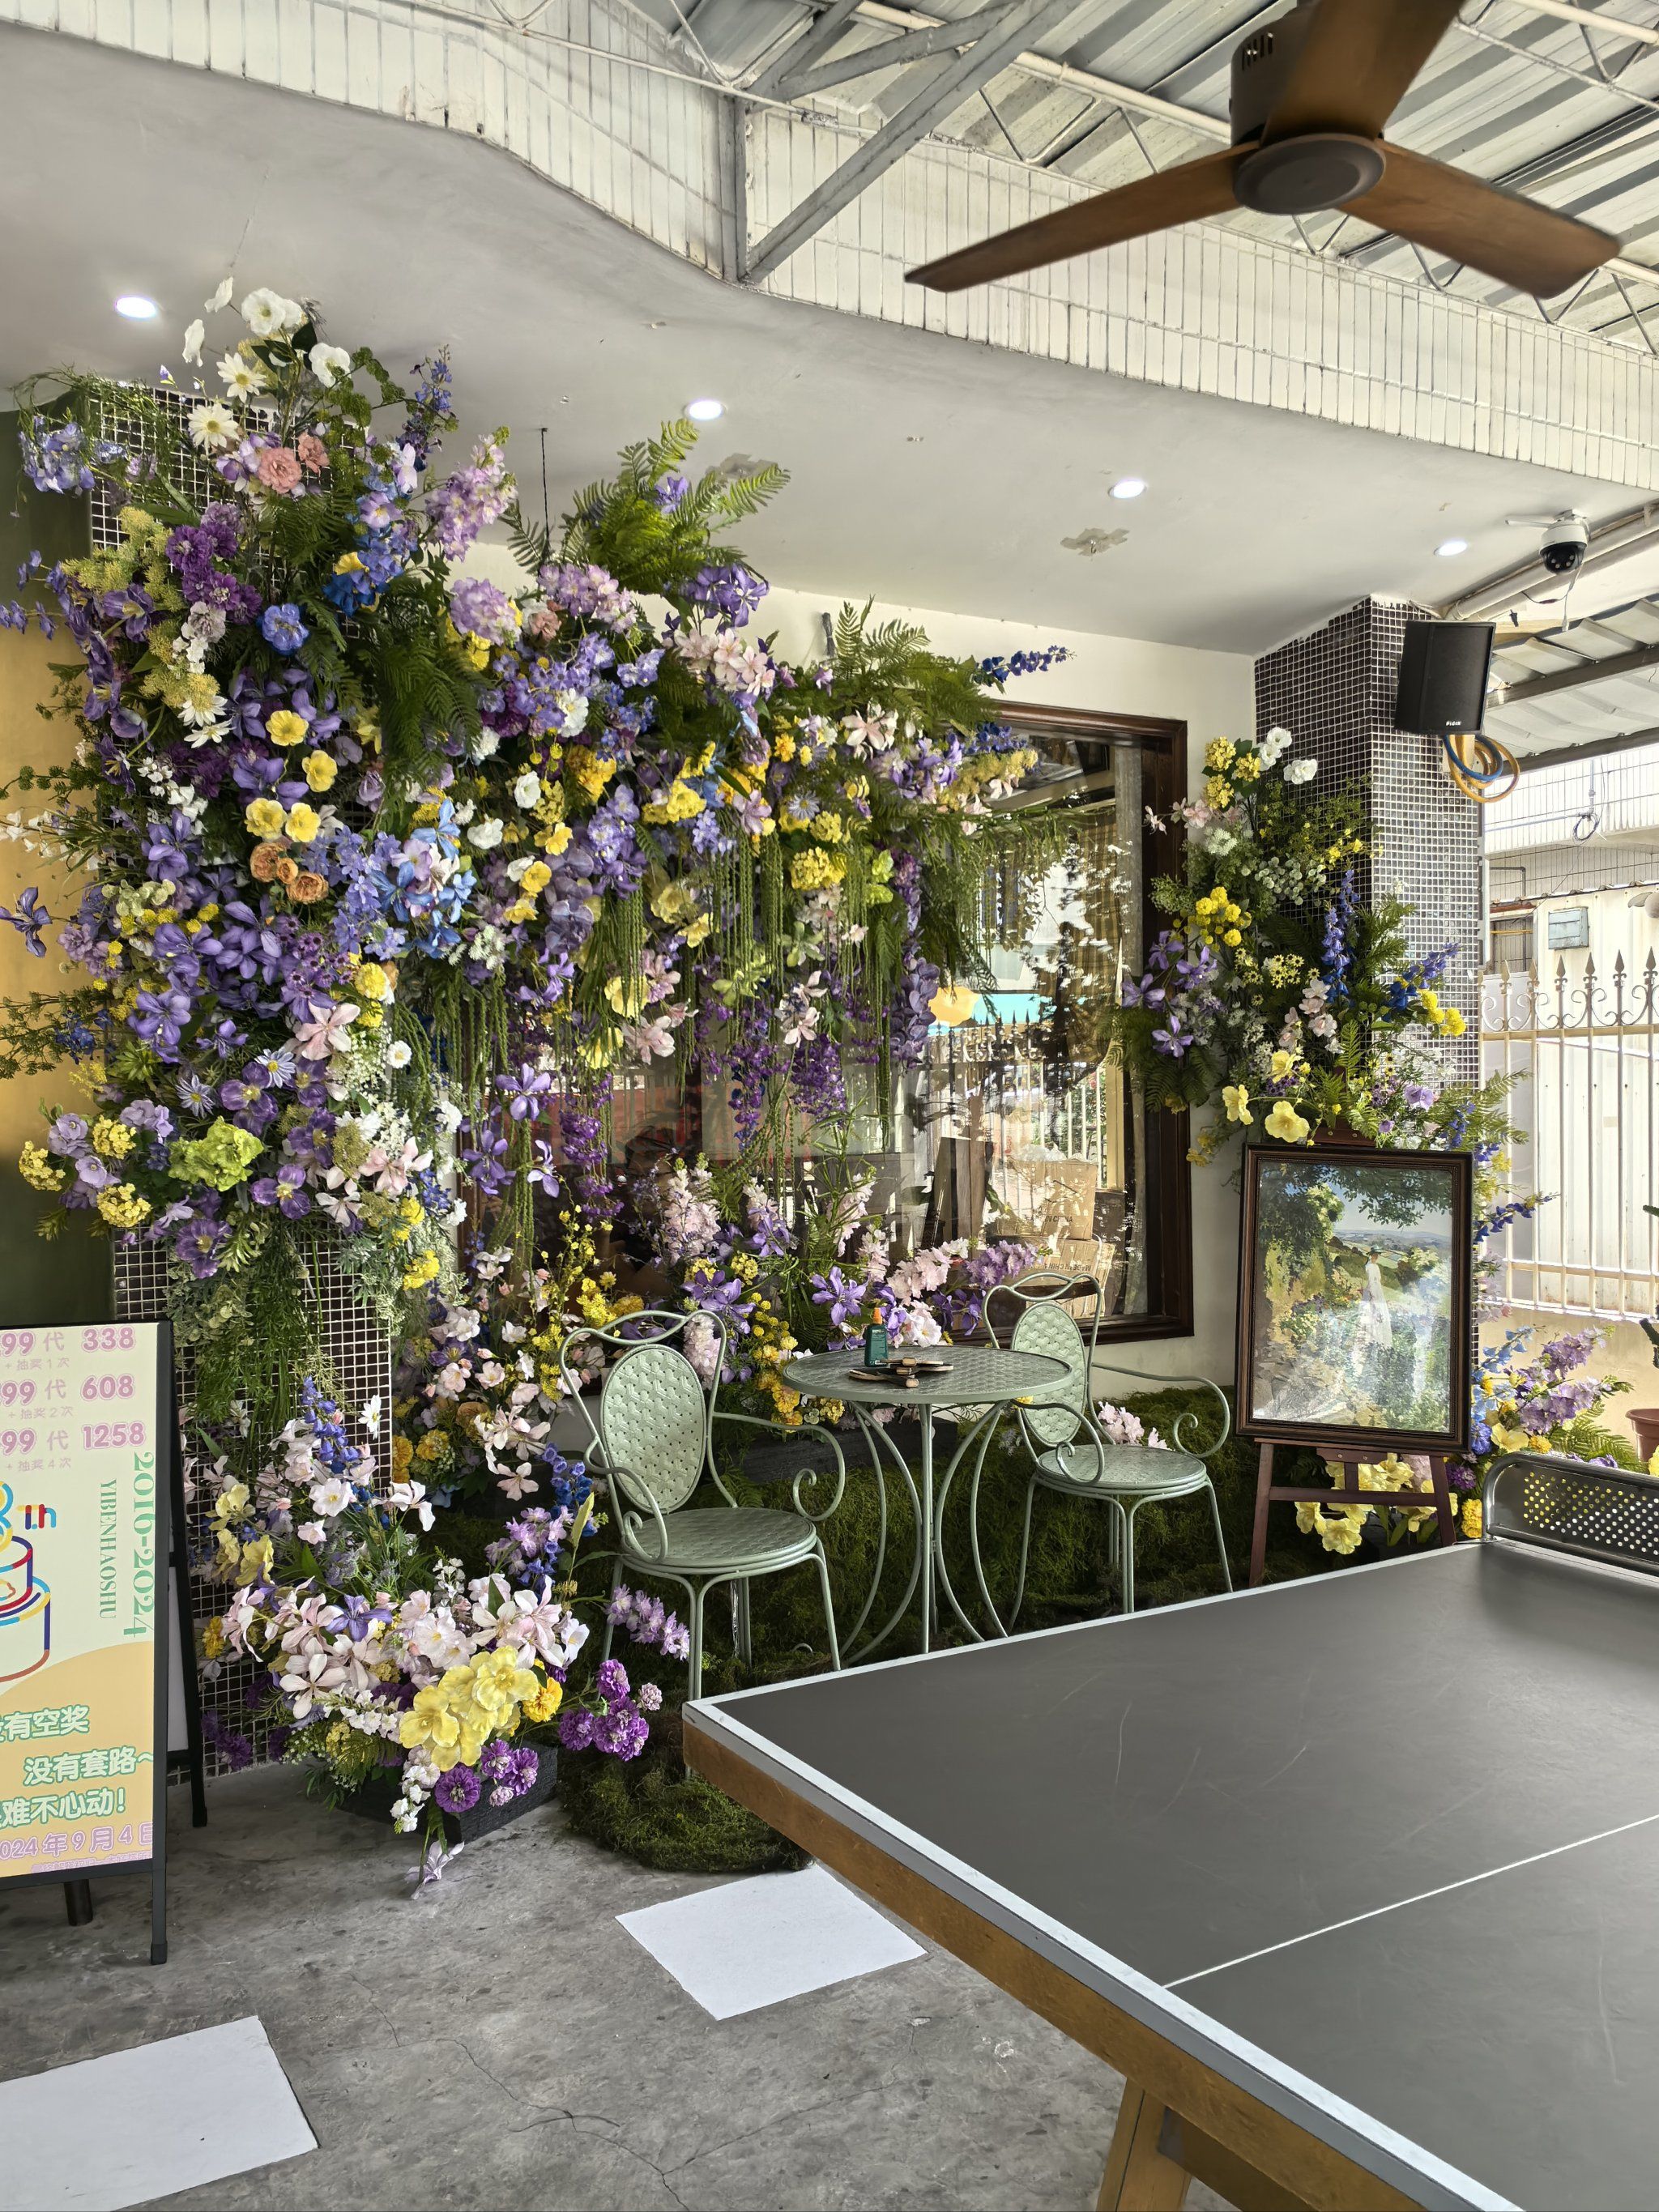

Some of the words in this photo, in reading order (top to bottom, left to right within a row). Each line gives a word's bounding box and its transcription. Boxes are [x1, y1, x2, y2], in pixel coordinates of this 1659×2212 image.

[43, 1332, 65, 1352] 代
[82, 1326, 136, 1353] 338
[45, 1379, 66, 1400] 代
[81, 1374, 136, 1400] 608
[46, 1430, 69, 1451] 代
[82, 1421, 146, 1450] 1258
[100, 1479, 117, 1619] YIBENHAOSHU
[123, 1451, 155, 1638] 2016-2024
[0, 1704, 90, 1741] 有空奖
[0, 1787, 126, 1831] 难不心动!
